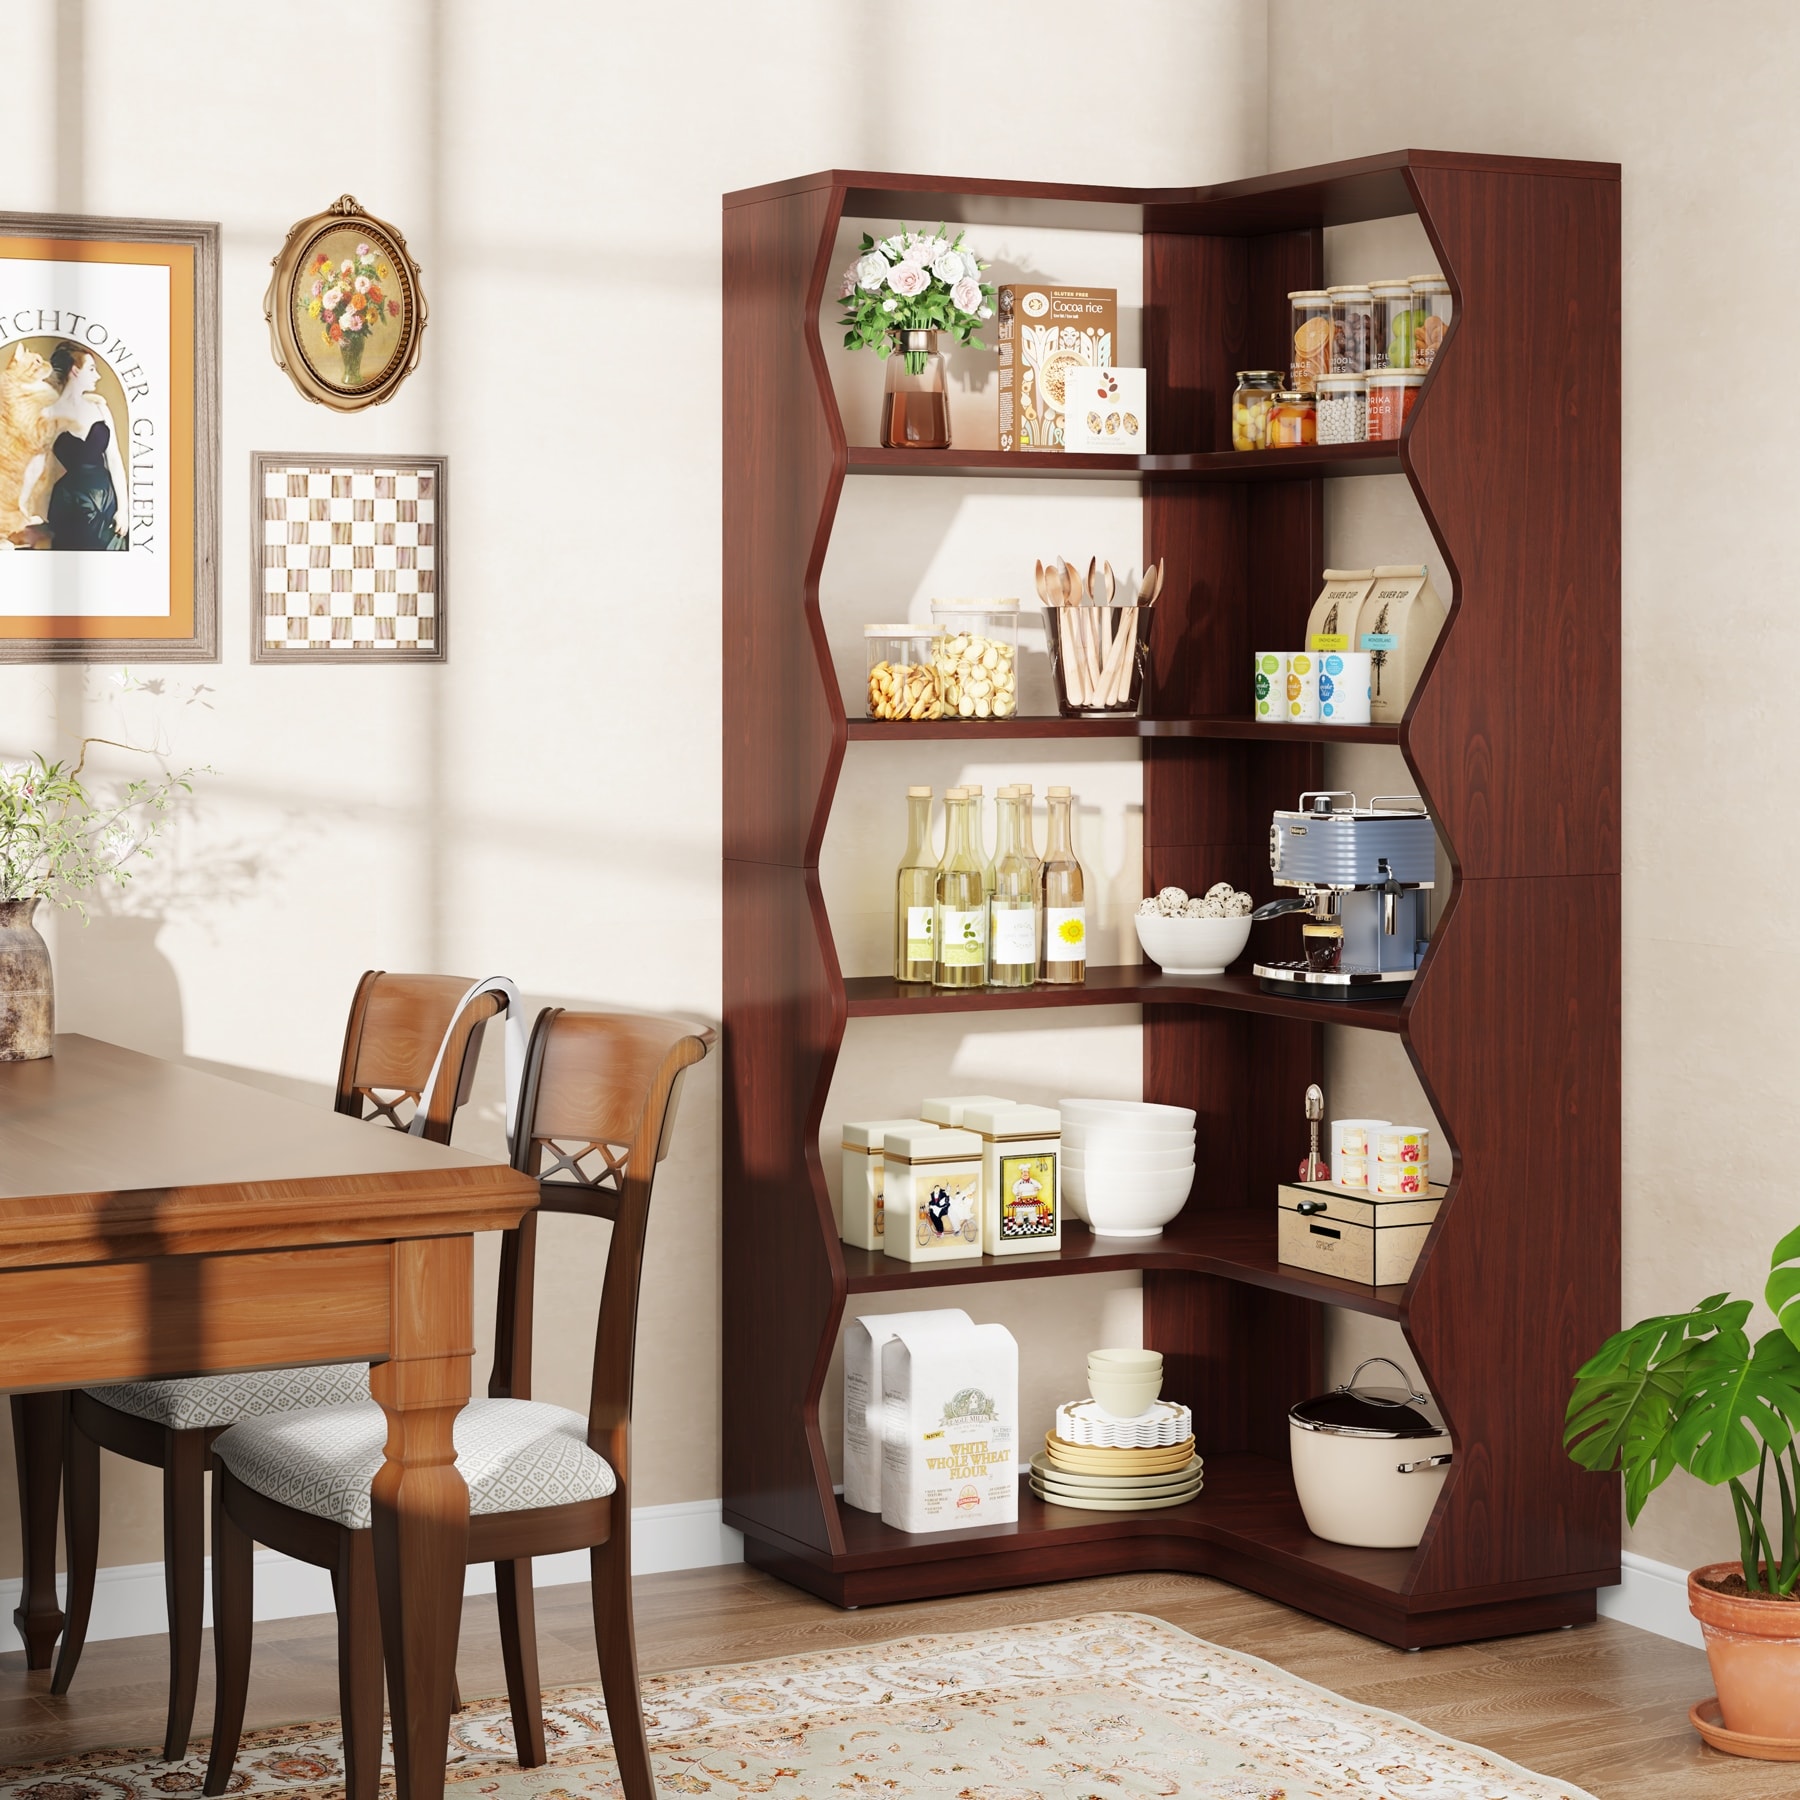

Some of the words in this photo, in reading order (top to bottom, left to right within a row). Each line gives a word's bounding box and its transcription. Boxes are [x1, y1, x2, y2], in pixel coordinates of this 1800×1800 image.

[1053, 300, 1083, 312] Cocoa
[1085, 302, 1103, 313] rice
[132, 417, 154, 555] GALLERY
[1328, 591, 1347, 599] SILVER
[1345, 591, 1358, 599] CUP
[1378, 591, 1398, 599] SILVER
[1396, 590, 1409, 599] CUP
[969, 1415, 989, 1423] MILLS
[949, 1440, 988, 1455] WHITE
[926, 1456, 968, 1470] WHOLE
[970, 1449, 1010, 1465] WHEAT
[949, 1465, 988, 1480] FLOUR
